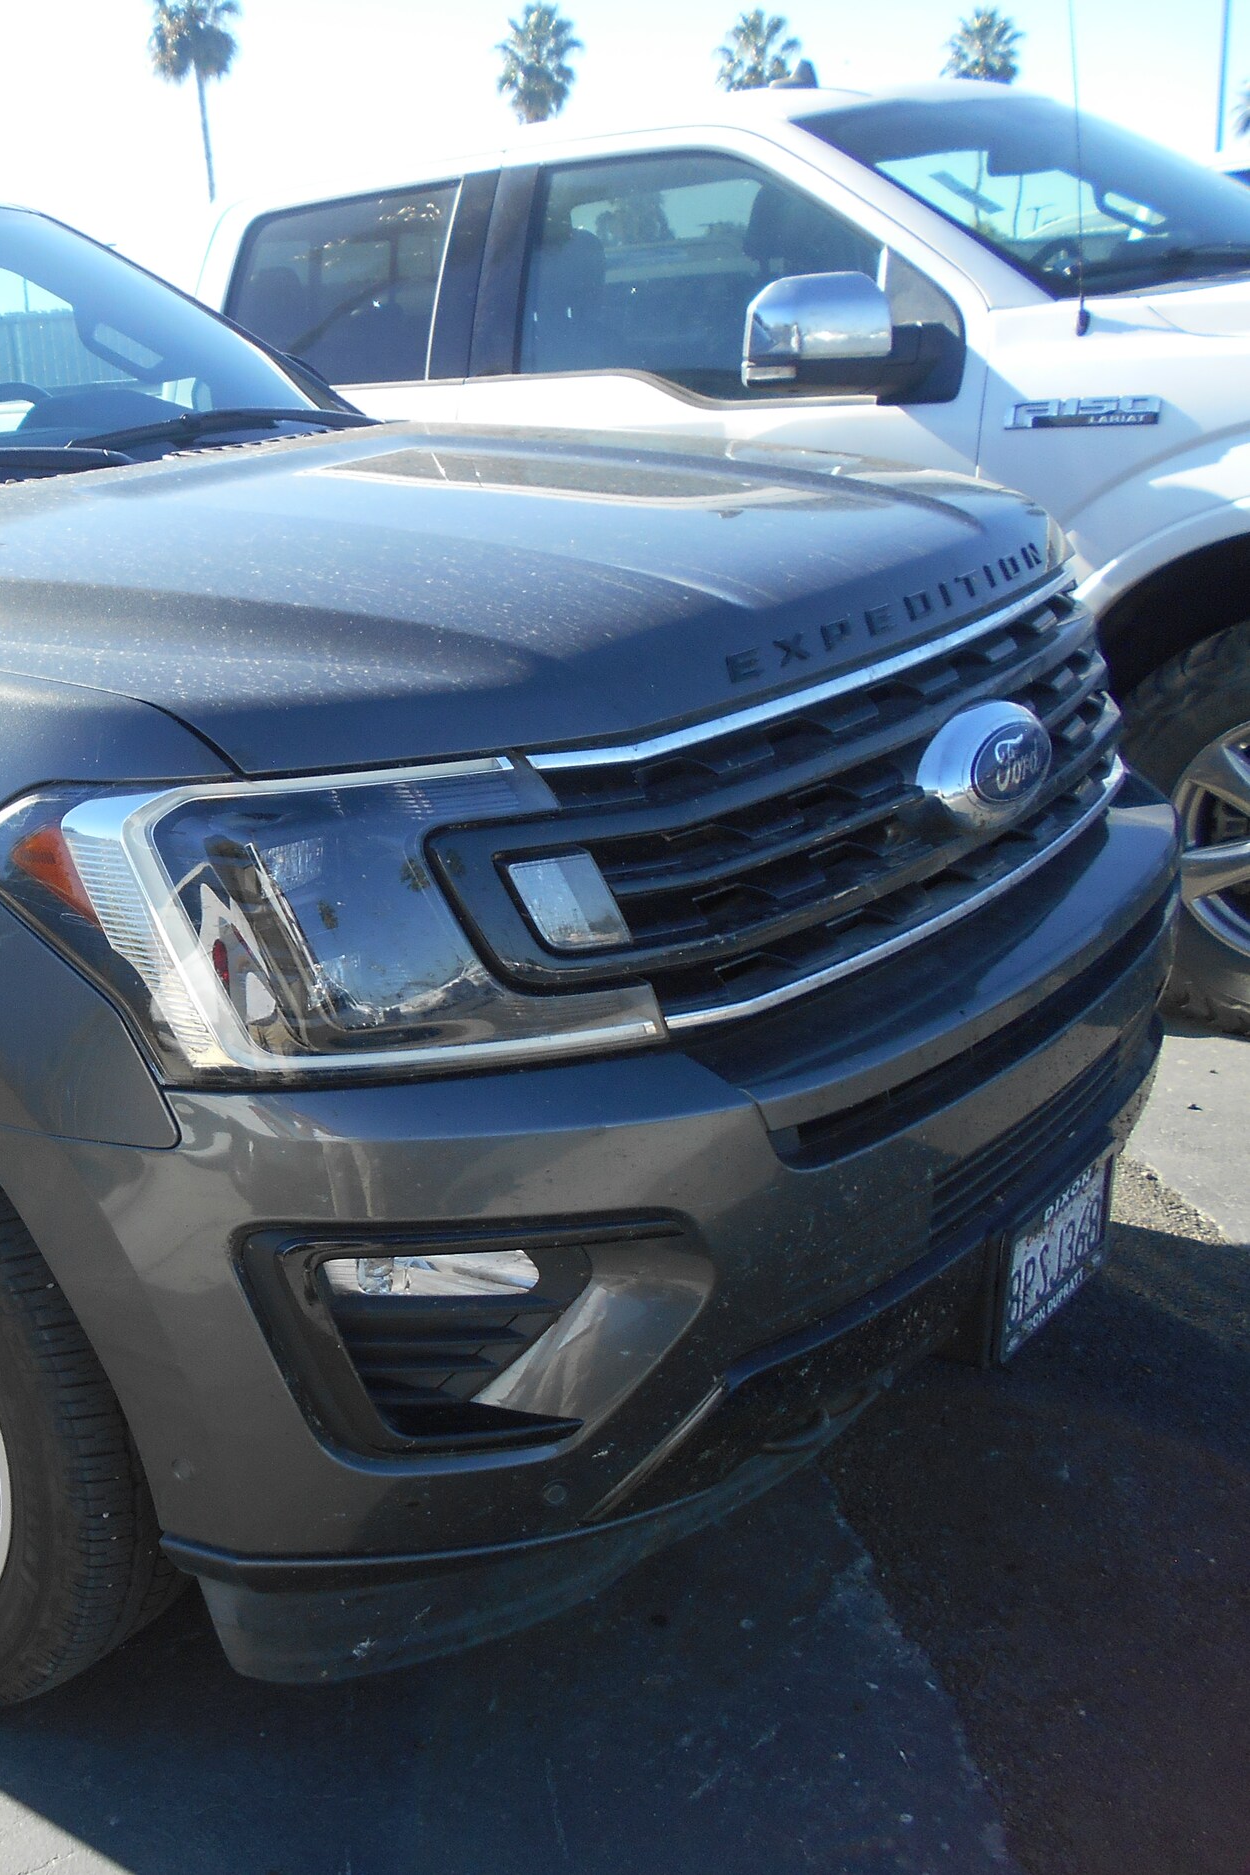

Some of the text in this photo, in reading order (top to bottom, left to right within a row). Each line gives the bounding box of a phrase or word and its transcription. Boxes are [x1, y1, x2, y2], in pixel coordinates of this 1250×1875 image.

[1088, 414, 1145, 424] LARIAT
[725, 541, 1043, 683] EXPEDITION
[994, 733, 1039, 792] Ford
[1044, 1168, 1091, 1222] DIXON
[1047, 1267, 1084, 1313] DUPRATT
